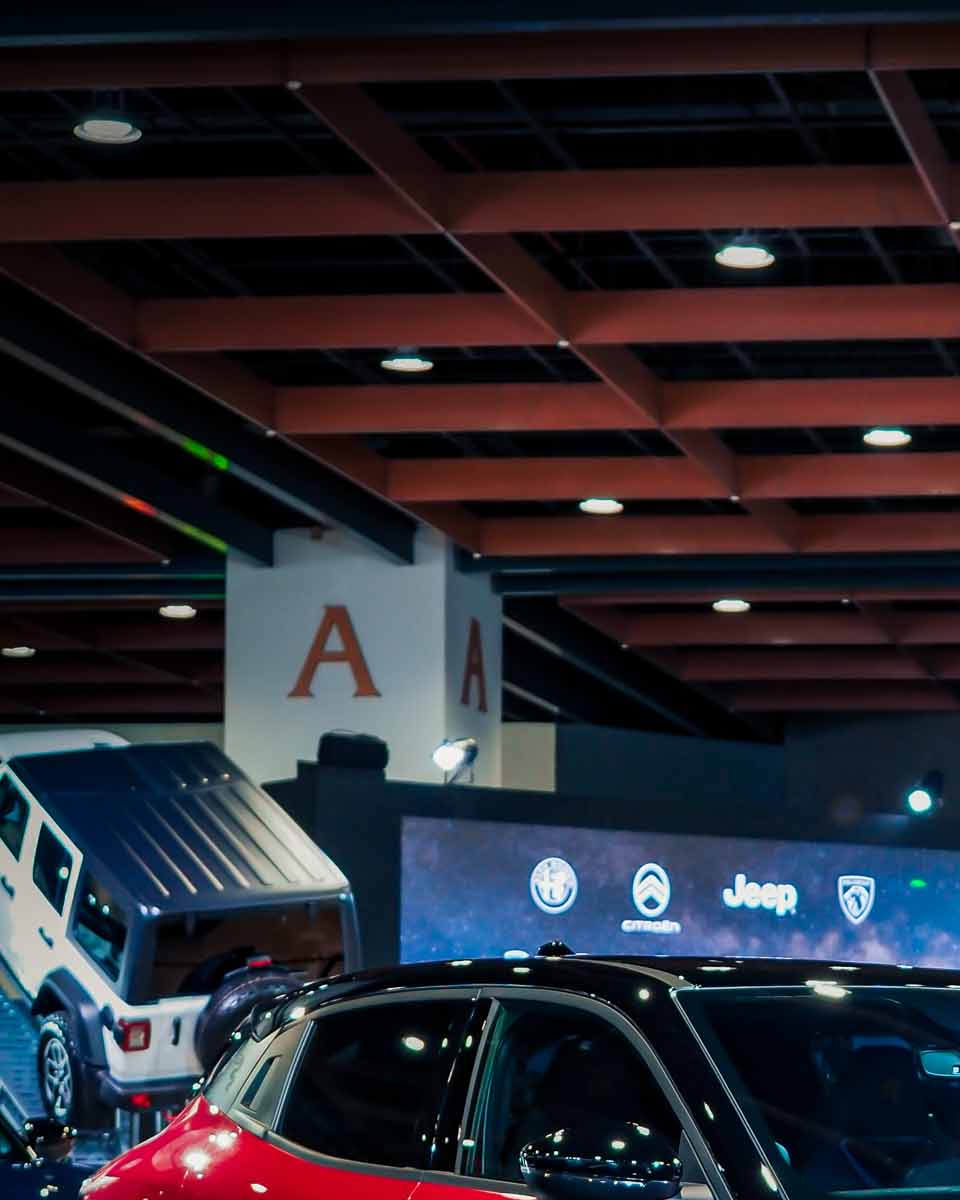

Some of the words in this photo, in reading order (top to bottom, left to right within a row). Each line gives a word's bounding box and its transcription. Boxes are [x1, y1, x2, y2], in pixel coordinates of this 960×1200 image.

[287, 604, 383, 698] A
[460, 617, 488, 713] A
[723, 873, 798, 916] Jeep
